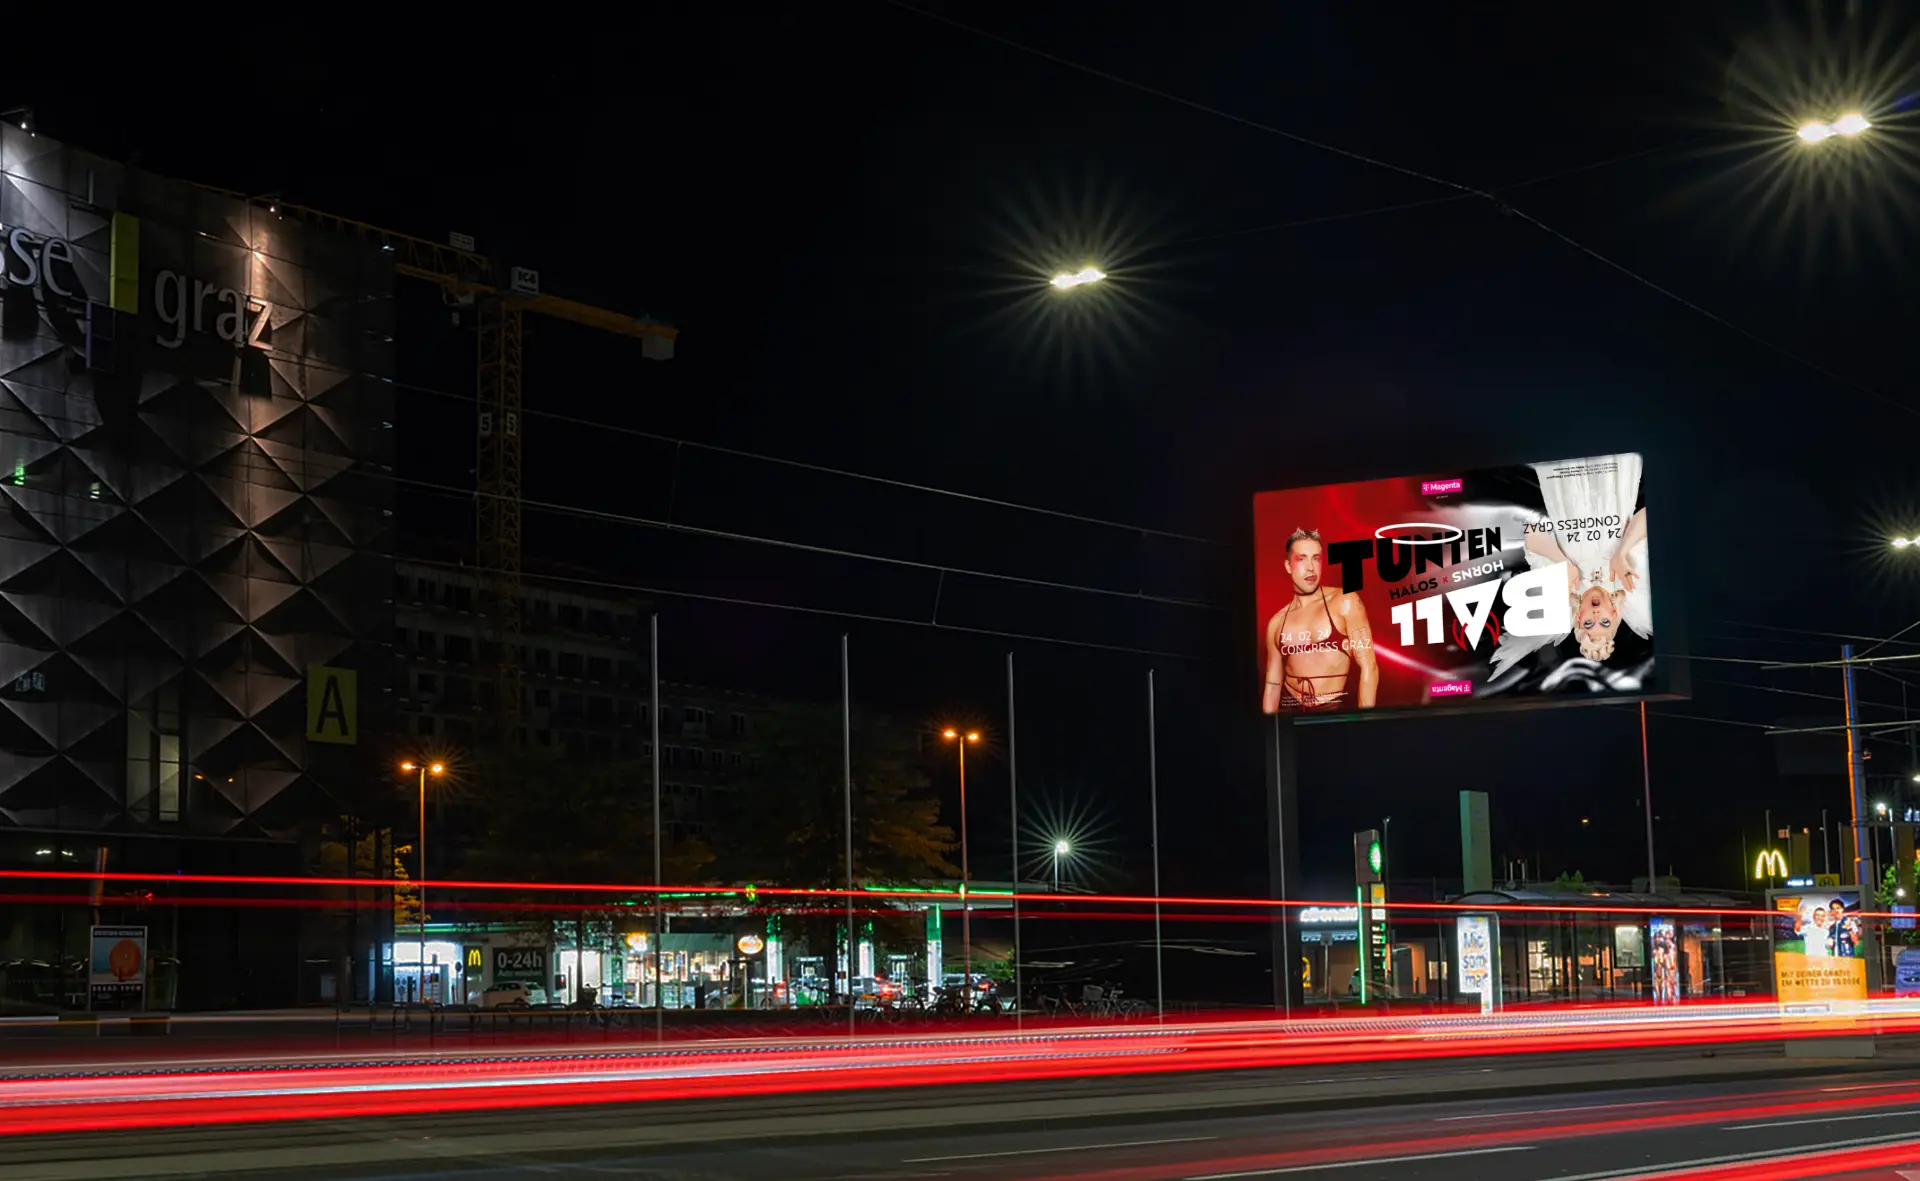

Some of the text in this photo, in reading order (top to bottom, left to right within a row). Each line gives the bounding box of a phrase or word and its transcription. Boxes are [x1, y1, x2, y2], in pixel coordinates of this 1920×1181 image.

[0, 222, 274, 351] se graz
[482, 415, 490, 432] 5
[1430, 481, 1461, 492] Magenta
[1523, 515, 1621, 534] CONGRESS GRAZ
[1567, 528, 1621, 543] 24 02 24
[1327, 526, 1503, 595] TUNTEN
[1389, 577, 1438, 600] HALOS
[1451, 560, 1505, 583] HORNS
[1391, 561, 1573, 652] BALL
[1280, 629, 1330, 643] 24 02 24
[1281, 638, 1373, 656] CONGRESS GRAZ
[1431, 683, 1463, 693] Magenta
[316, 674, 349, 736] A
[498, 951, 543, 968] 0-24h
